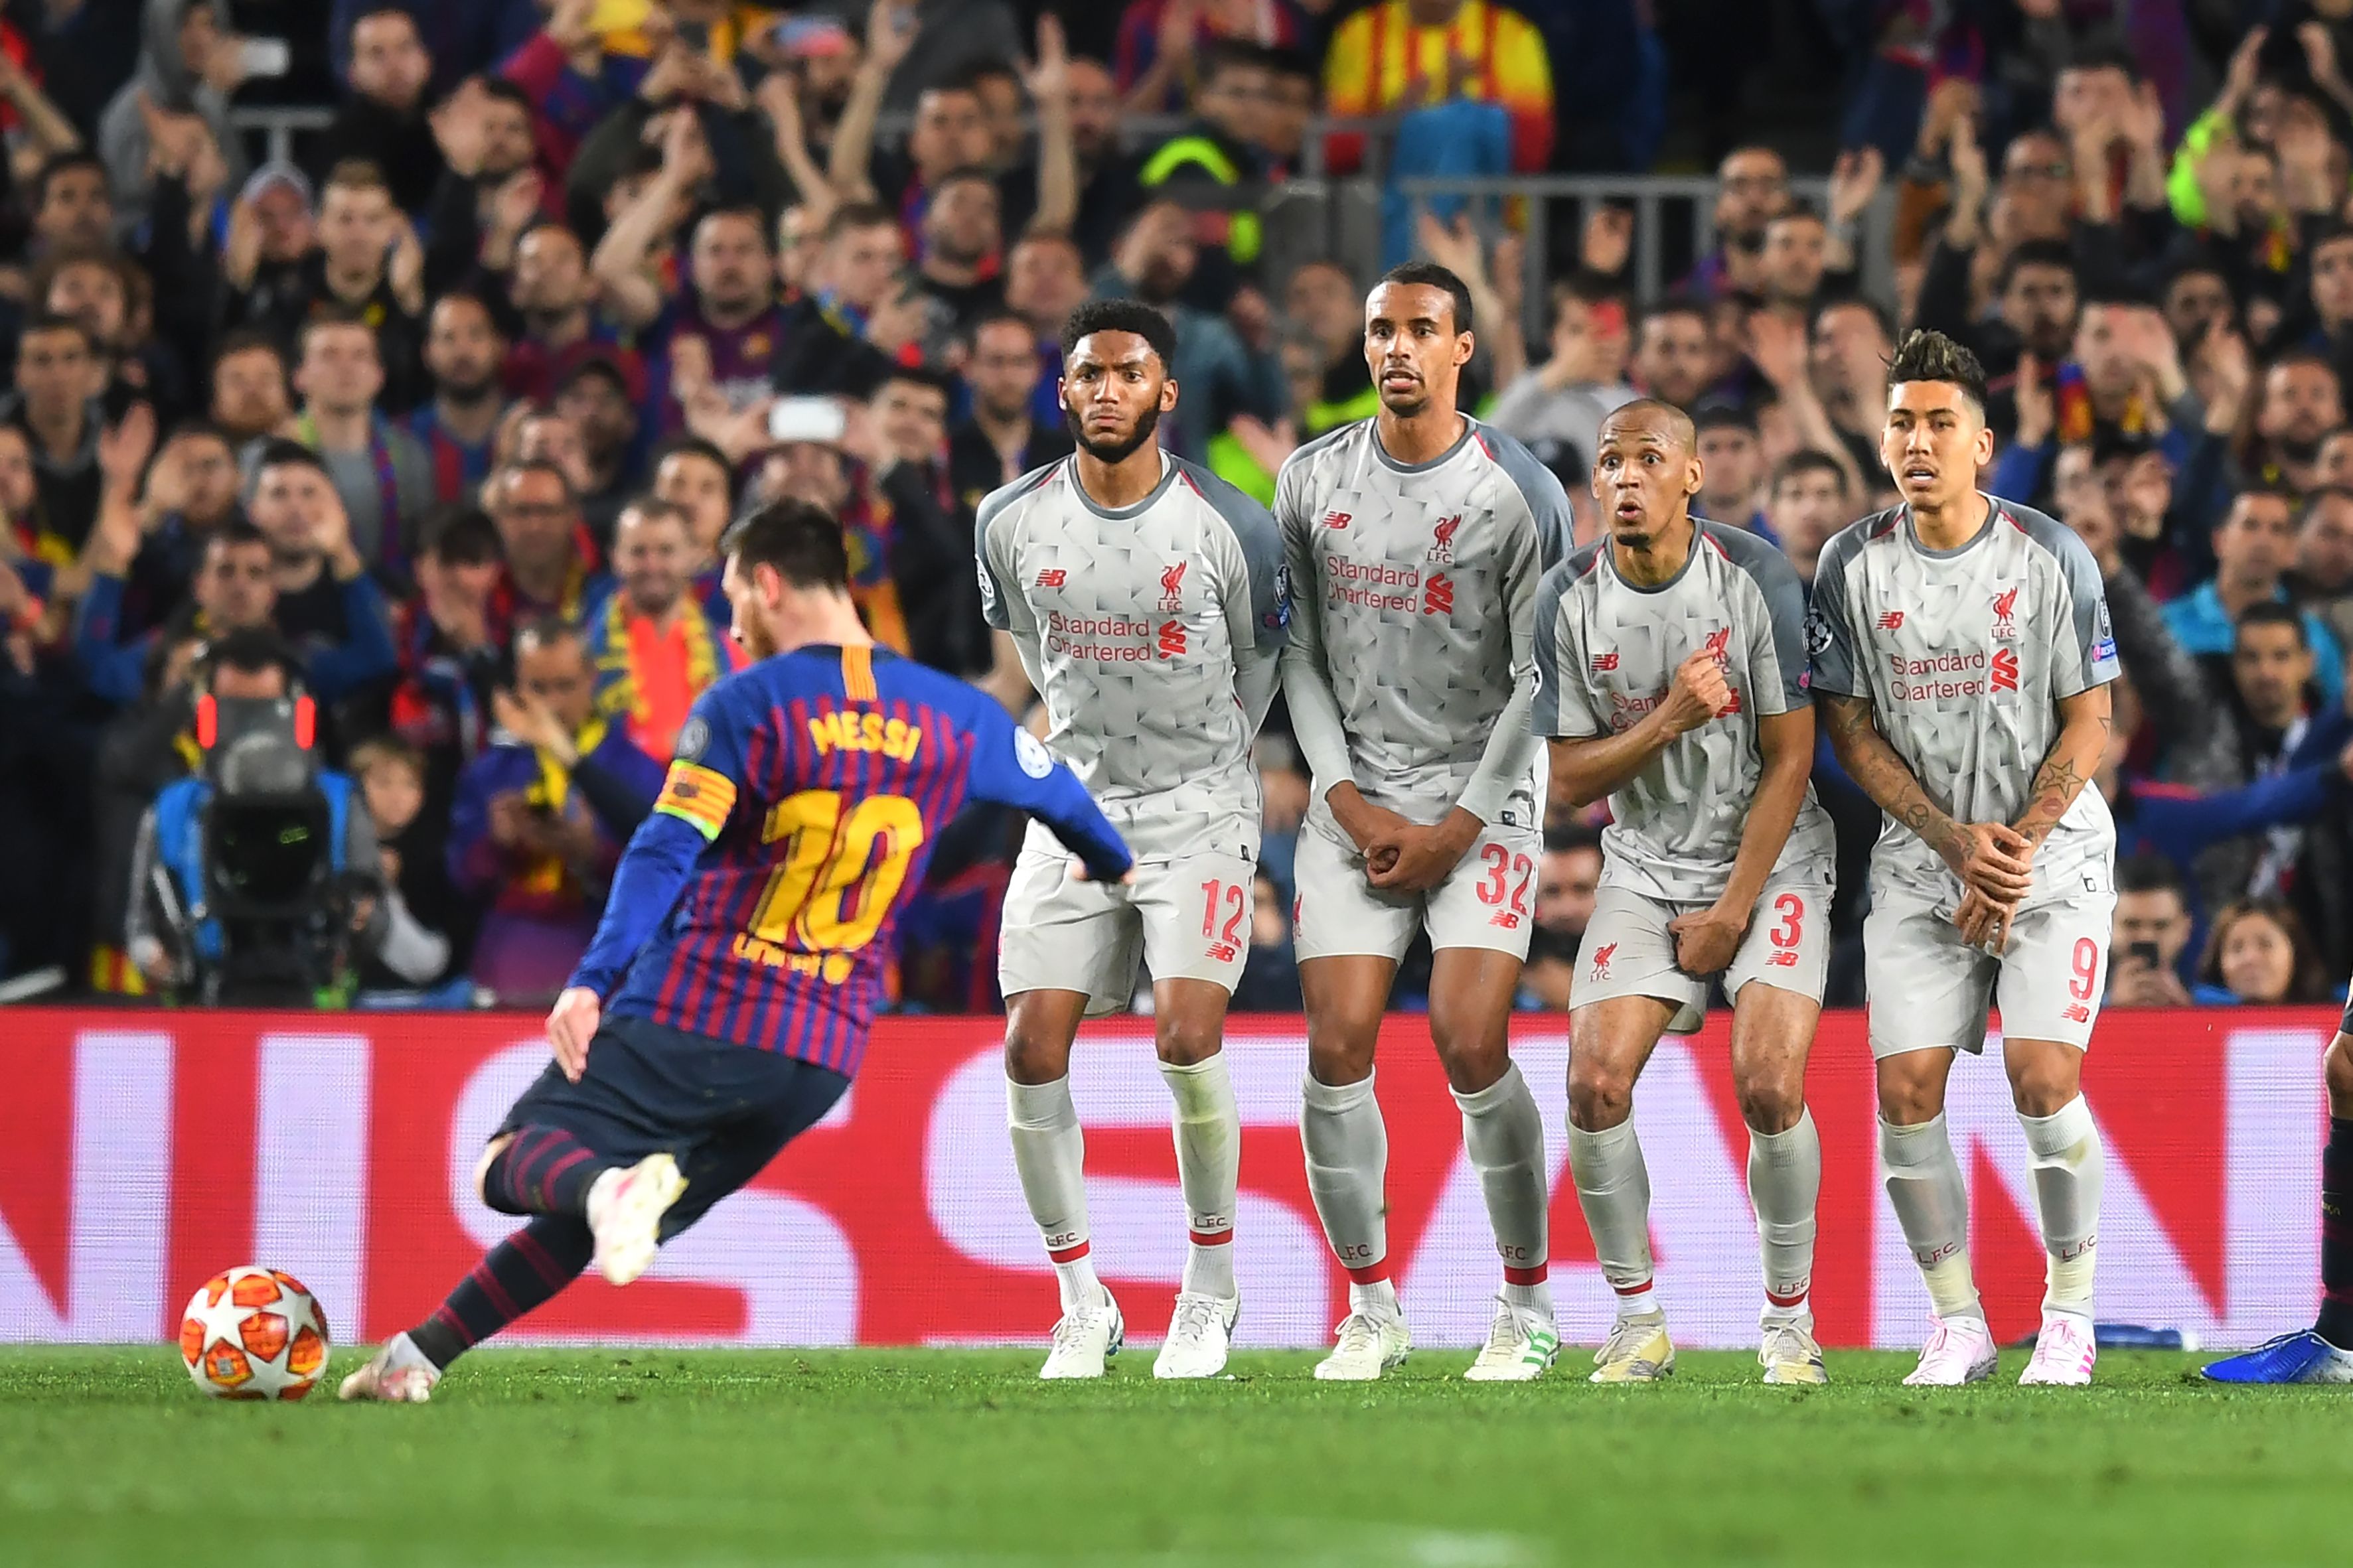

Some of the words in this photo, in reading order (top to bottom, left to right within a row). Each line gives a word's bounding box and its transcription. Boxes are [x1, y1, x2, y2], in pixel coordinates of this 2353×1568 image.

[1328, 556, 1419, 588] Standard
[1047, 635, 1151, 662] Chartered
[1049, 612, 1150, 637] Standard
[808, 710, 923, 764] MESSI
[748, 788, 925, 953] 10
[1476, 843, 1533, 916] 32
[1201, 879, 1244, 949] 12
[1770, 892, 1804, 948] 3
[2068, 937, 2098, 1001] 9
